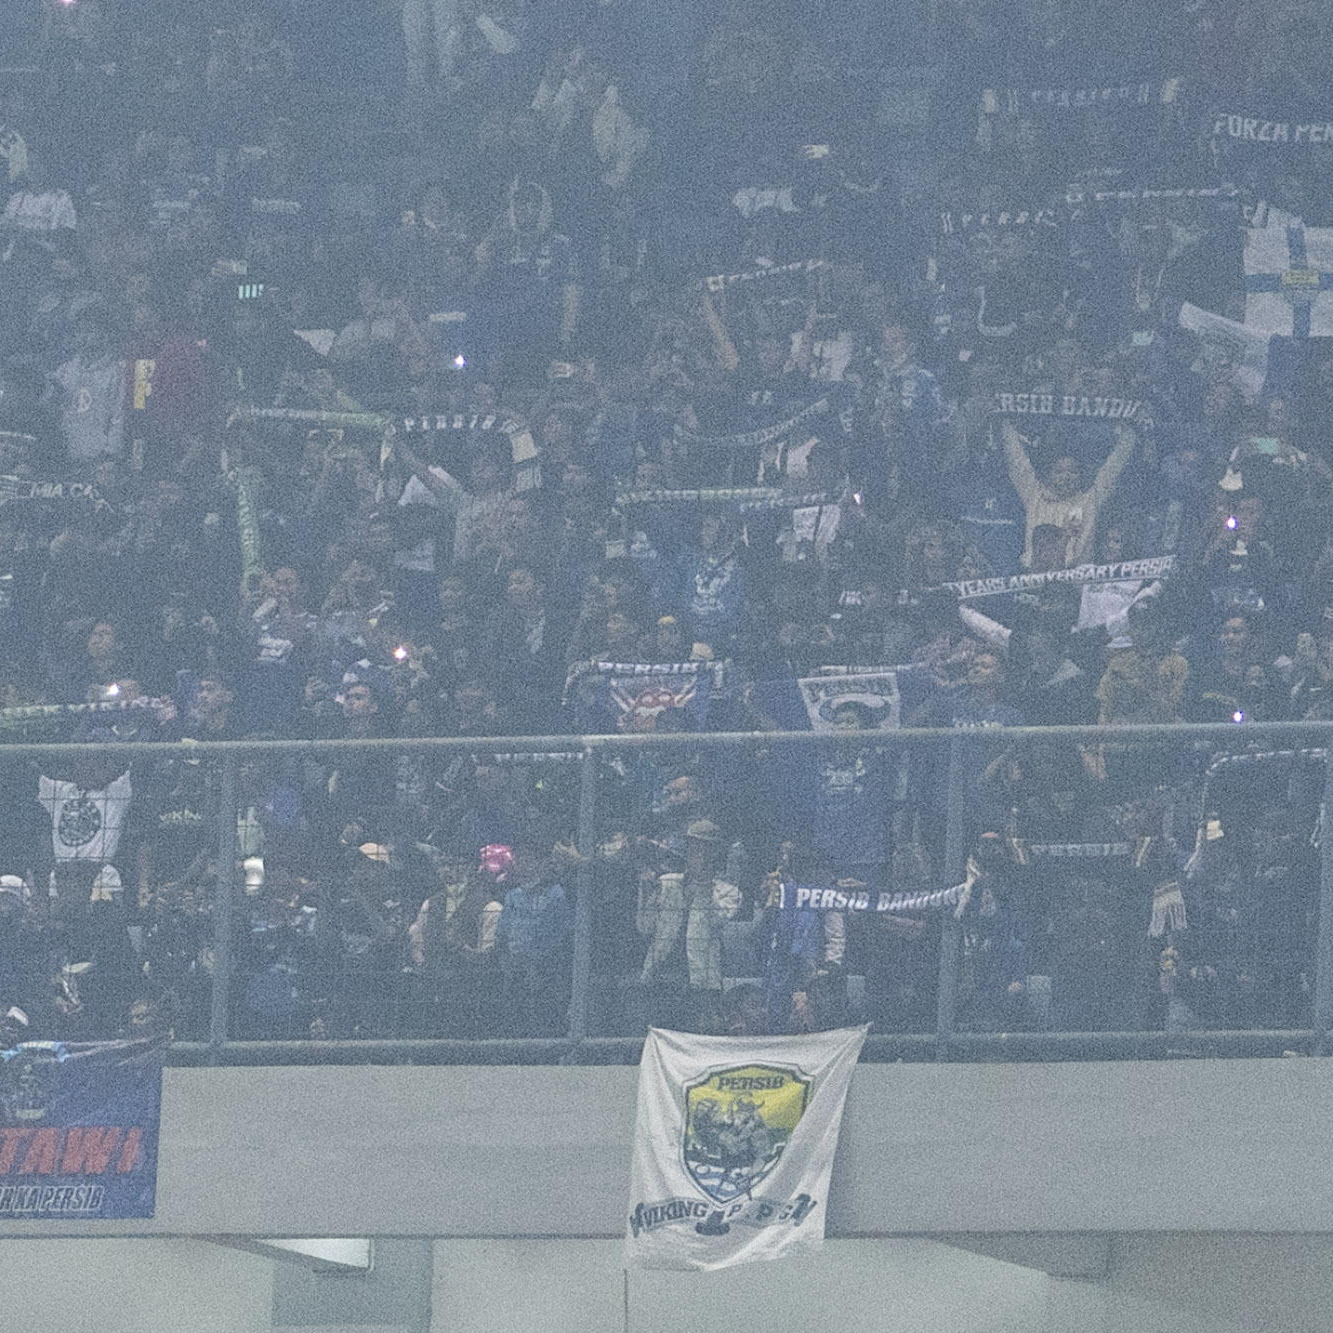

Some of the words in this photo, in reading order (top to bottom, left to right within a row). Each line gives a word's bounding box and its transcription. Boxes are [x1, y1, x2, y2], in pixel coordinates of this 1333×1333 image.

[717, 1076, 785, 1092] PERSIB
[40, 1185, 105, 1212] PERSIB
[641, 1201, 709, 1228] VIKING
